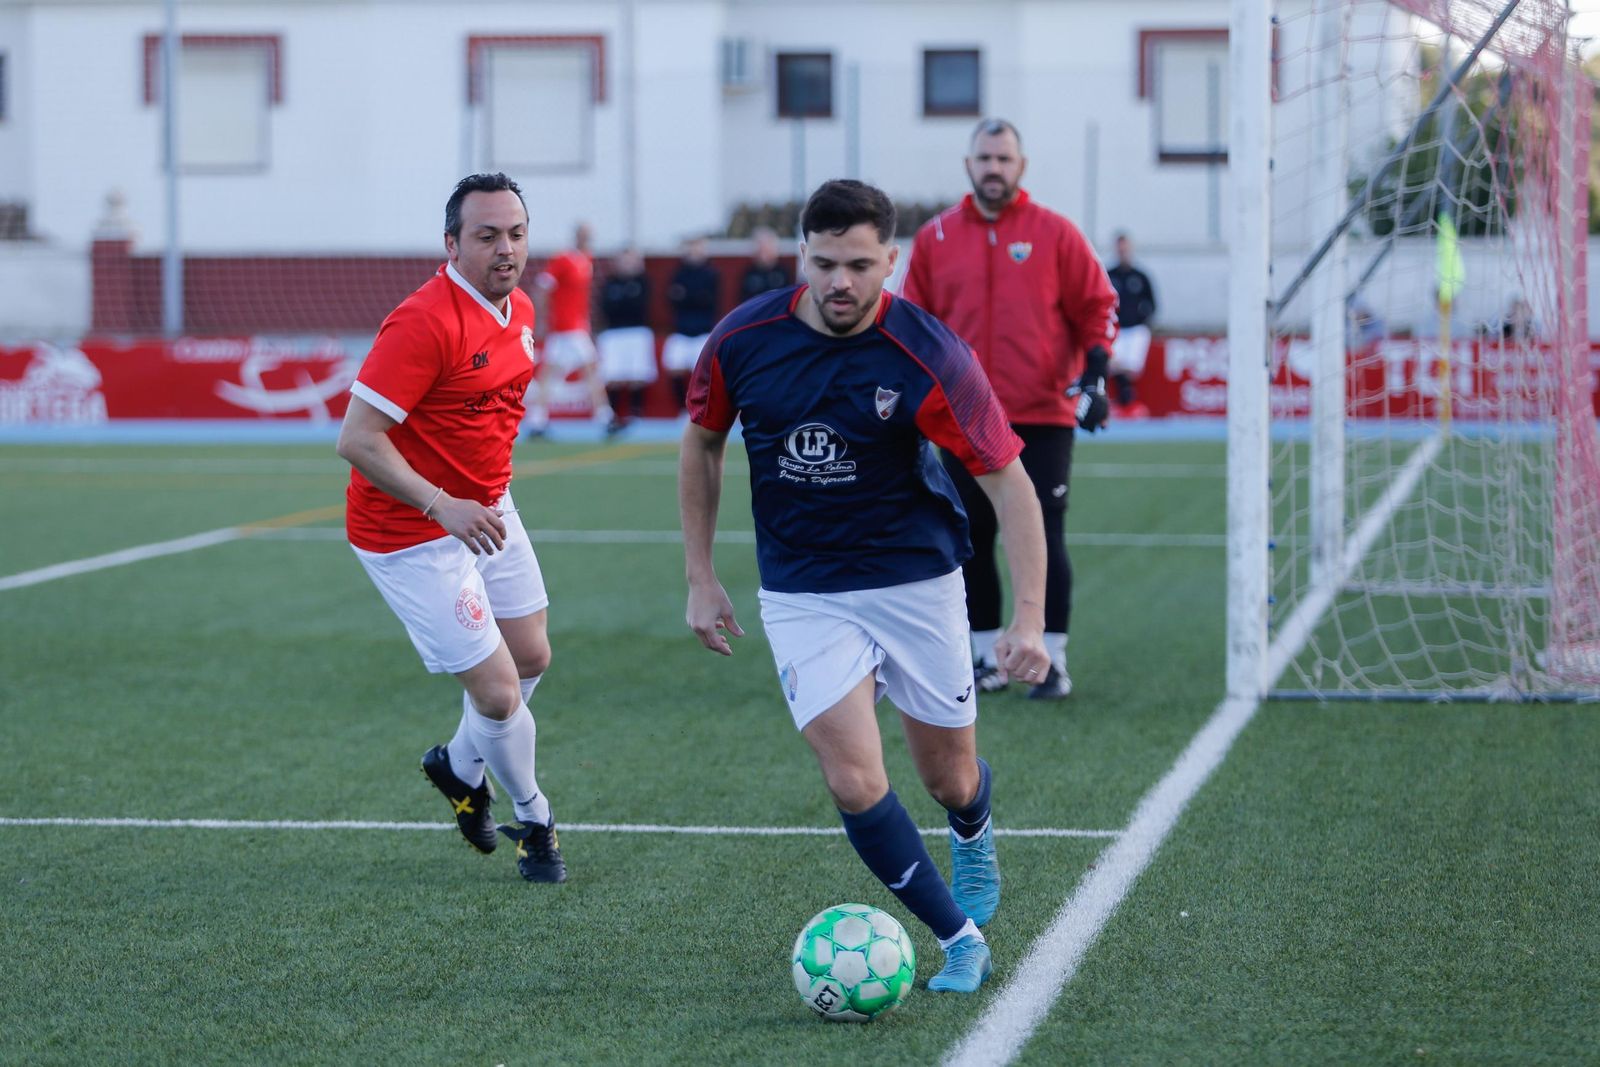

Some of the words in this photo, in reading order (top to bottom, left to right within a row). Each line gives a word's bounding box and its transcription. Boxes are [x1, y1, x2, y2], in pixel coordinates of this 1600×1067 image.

[781, 459, 805, 470] Grupo
[824, 463, 853, 471] Palma
[780, 470, 806, 482] Juega
[811, 475, 856, 485] Diferente
